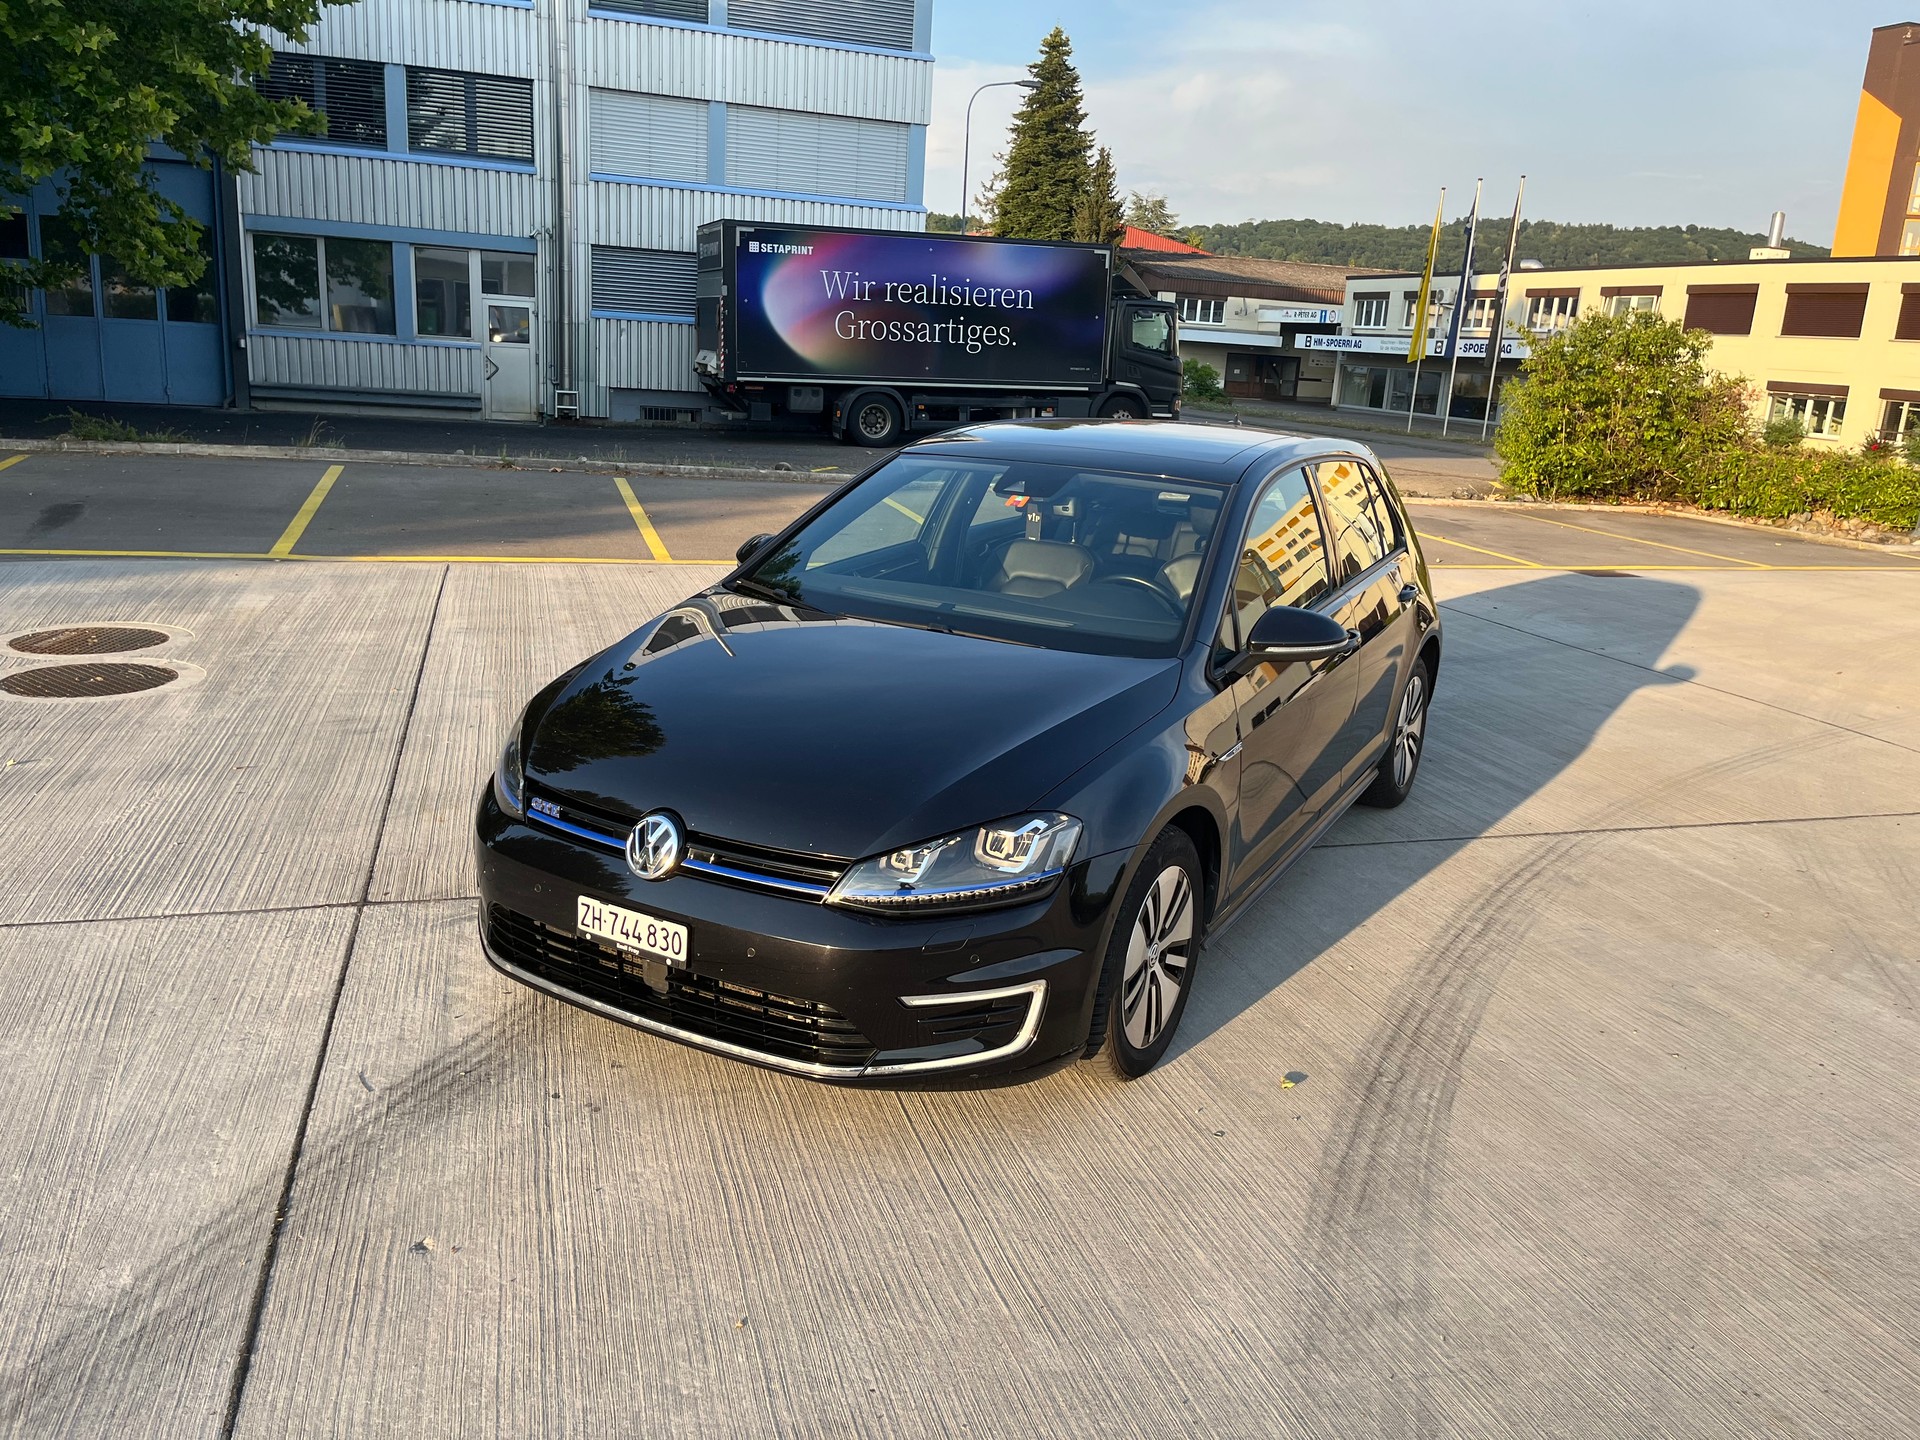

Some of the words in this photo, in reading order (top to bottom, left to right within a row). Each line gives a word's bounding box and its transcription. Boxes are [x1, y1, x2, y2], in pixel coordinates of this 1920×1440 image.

[760, 243, 814, 255] SETAPRINT
[820, 269, 876, 302] Wir
[884, 273, 1034, 309] realisieren
[834, 310, 1017, 354] Grossartiges.
[1353, 340, 1362, 349] AG
[531, 797, 561, 819] GTE
